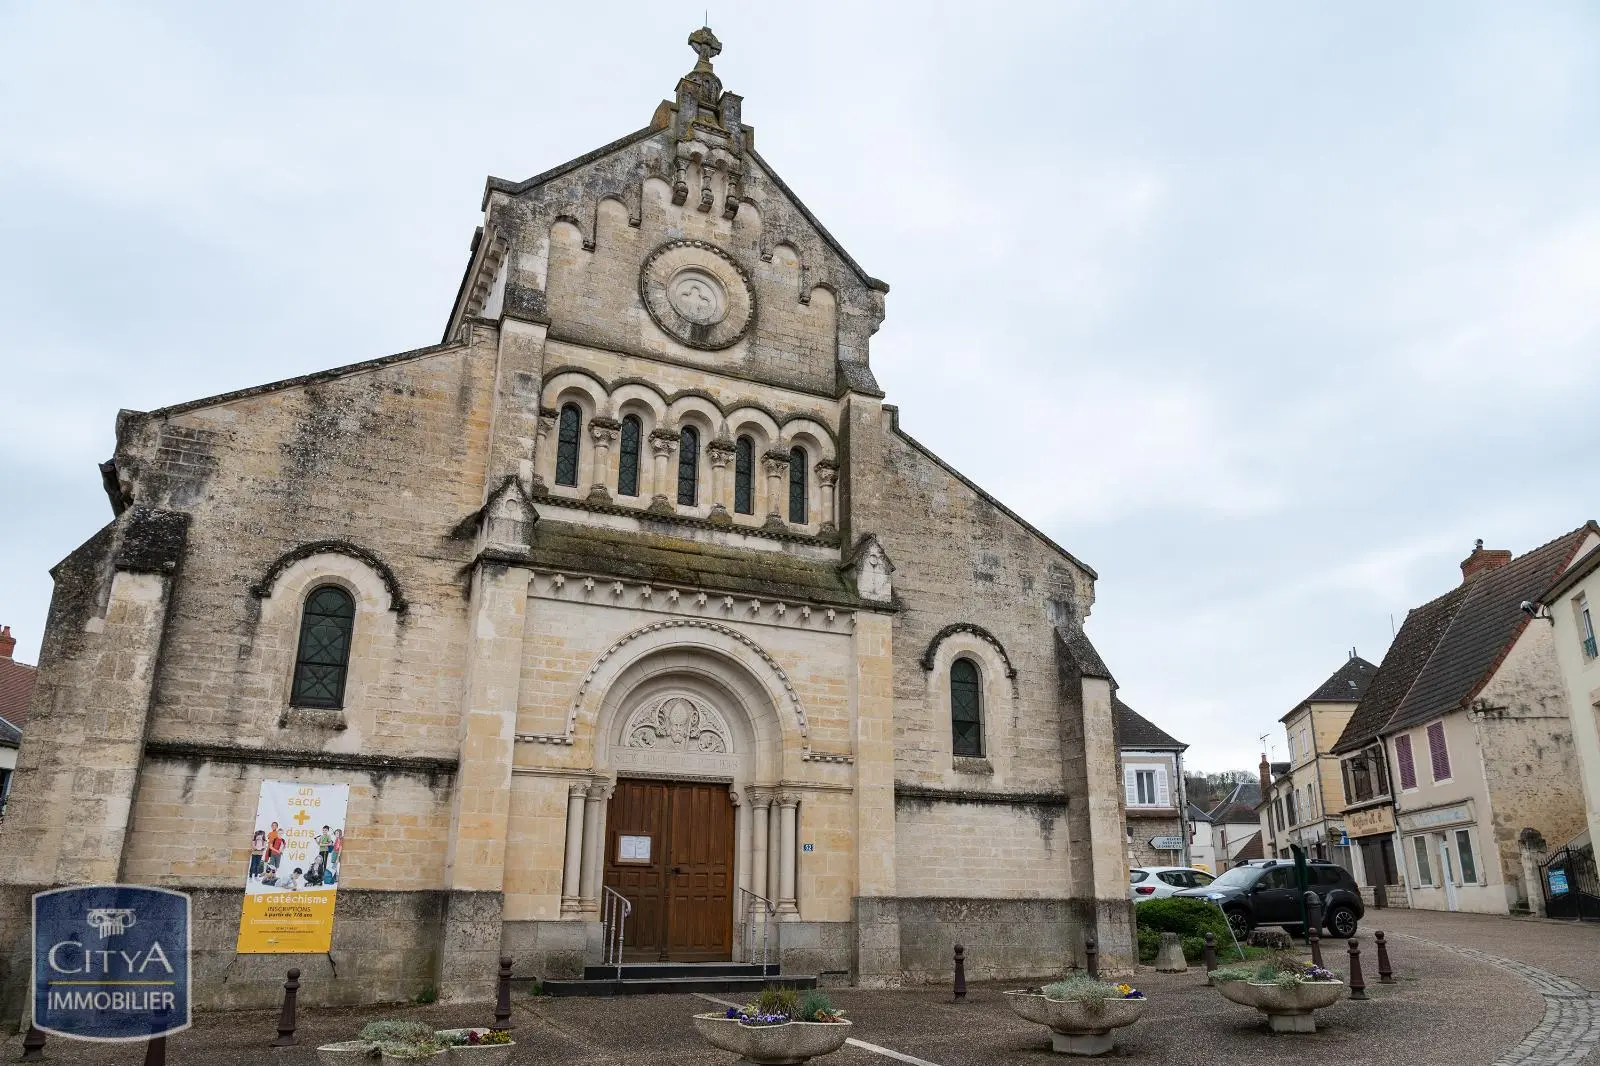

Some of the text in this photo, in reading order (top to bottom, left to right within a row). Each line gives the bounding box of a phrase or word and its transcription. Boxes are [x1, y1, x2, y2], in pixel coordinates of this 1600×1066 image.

[298, 787, 313, 796] un
[287, 797, 321, 807] sacré
[286, 827, 315, 838] dans
[287, 839, 309, 849] leur
[288, 851, 306, 861] vie
[253, 894, 328, 904] le catéchisme
